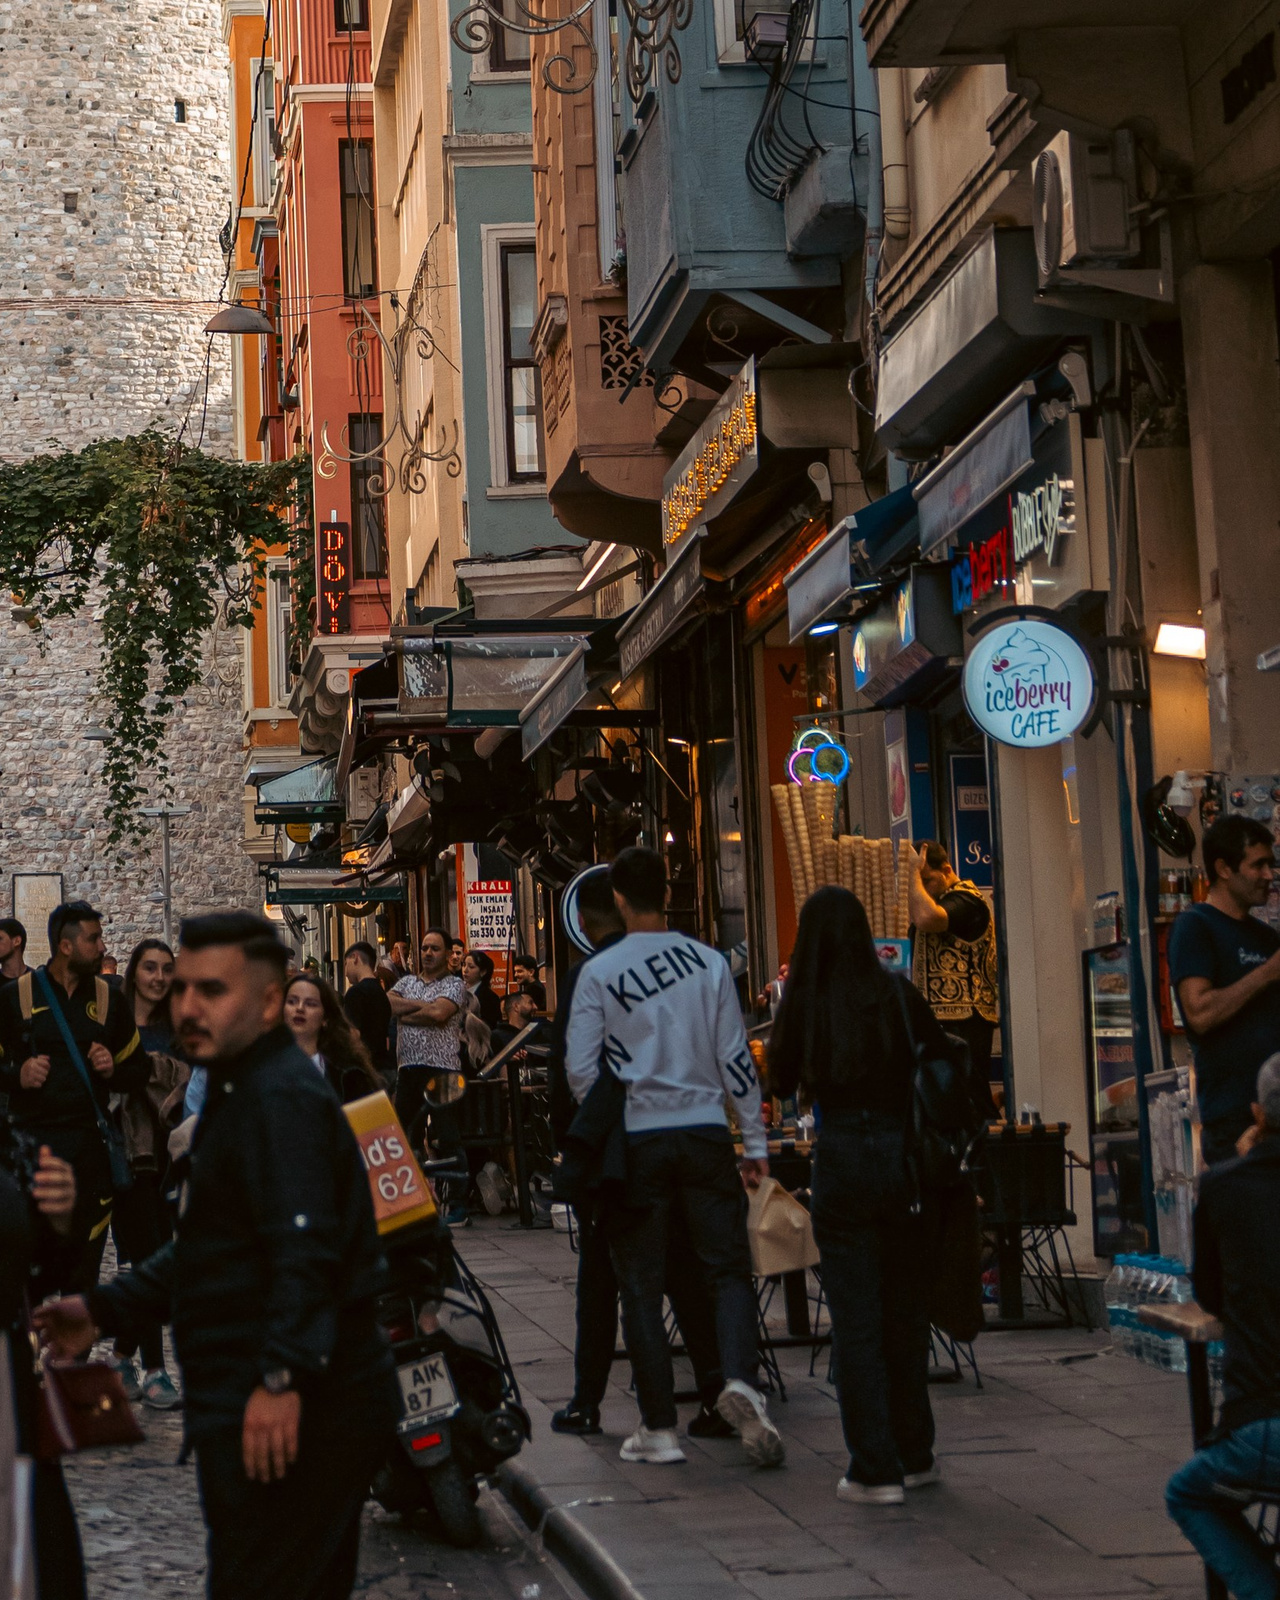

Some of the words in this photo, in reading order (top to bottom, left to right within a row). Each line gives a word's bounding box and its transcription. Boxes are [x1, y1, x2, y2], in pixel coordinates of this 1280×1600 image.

[985, 678, 1071, 712] iceberry
[1011, 709, 1061, 738] CAFE
[965, 841, 991, 865] Ic
[467, 881, 509, 891] KİRALI
[480, 915, 493, 925] 927
[495, 916, 504, 925] 53
[481, 905, 504, 914] İNŞAAT
[481, 928, 494, 938] 330
[606, 943, 708, 1014] KLEIN
[726, 1050, 756, 1098] JE
[378, 1165, 418, 1201] 62
[408, 1387, 432, 1411] 87
